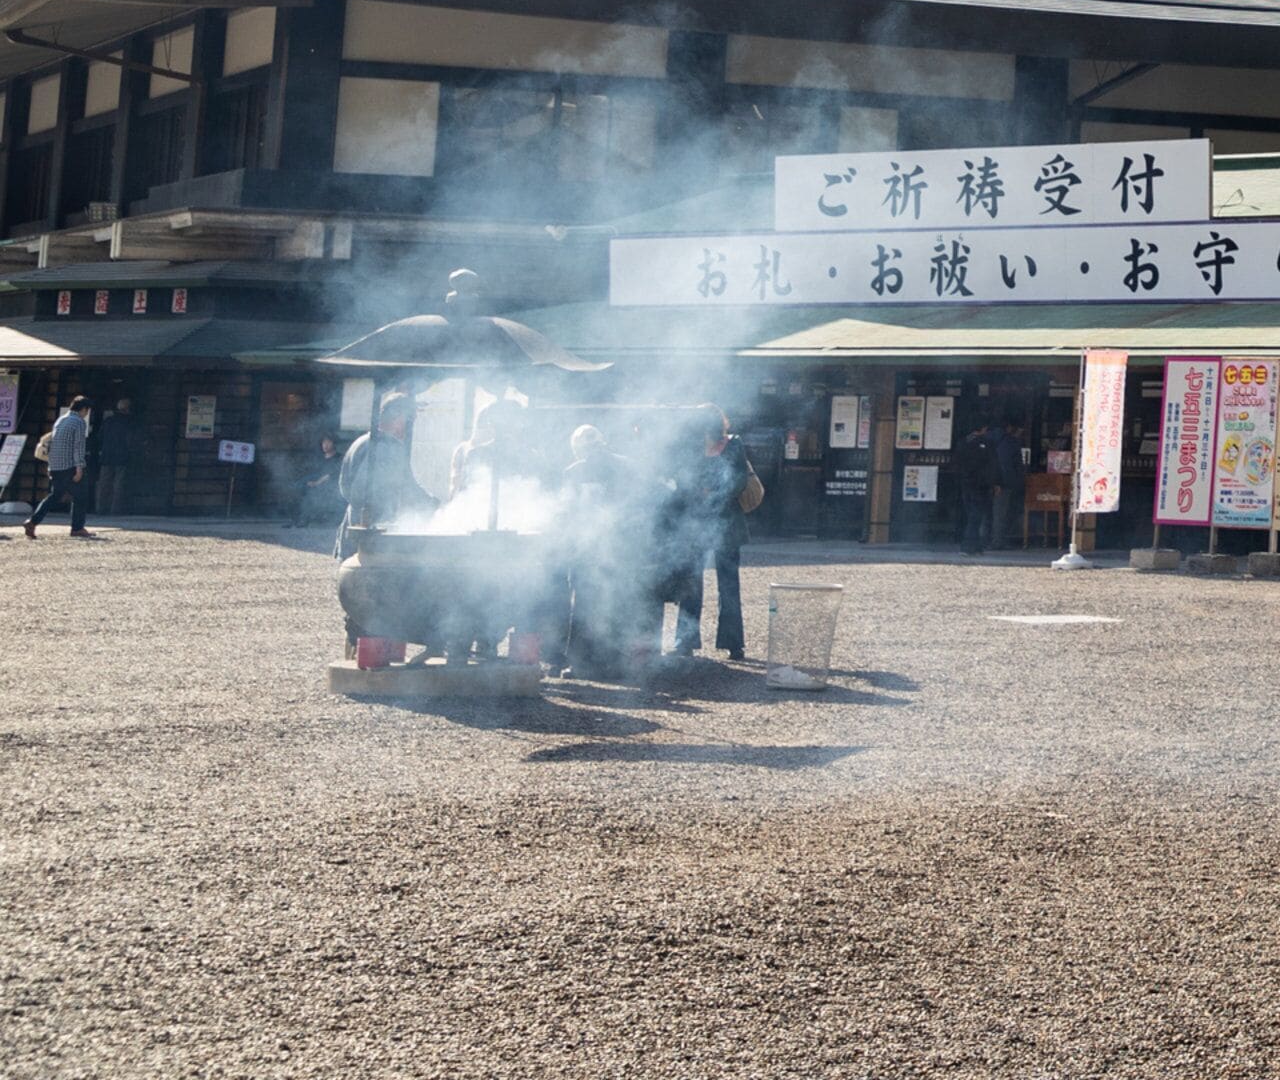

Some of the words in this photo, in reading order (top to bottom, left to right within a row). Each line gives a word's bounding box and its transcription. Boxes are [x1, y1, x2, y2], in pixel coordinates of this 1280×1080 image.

[817, 153, 1165, 220] ご祈祷受付
[1225, 366, 1266, 384] 七五三
[1177, 366, 1204, 514] 七五三まつり
